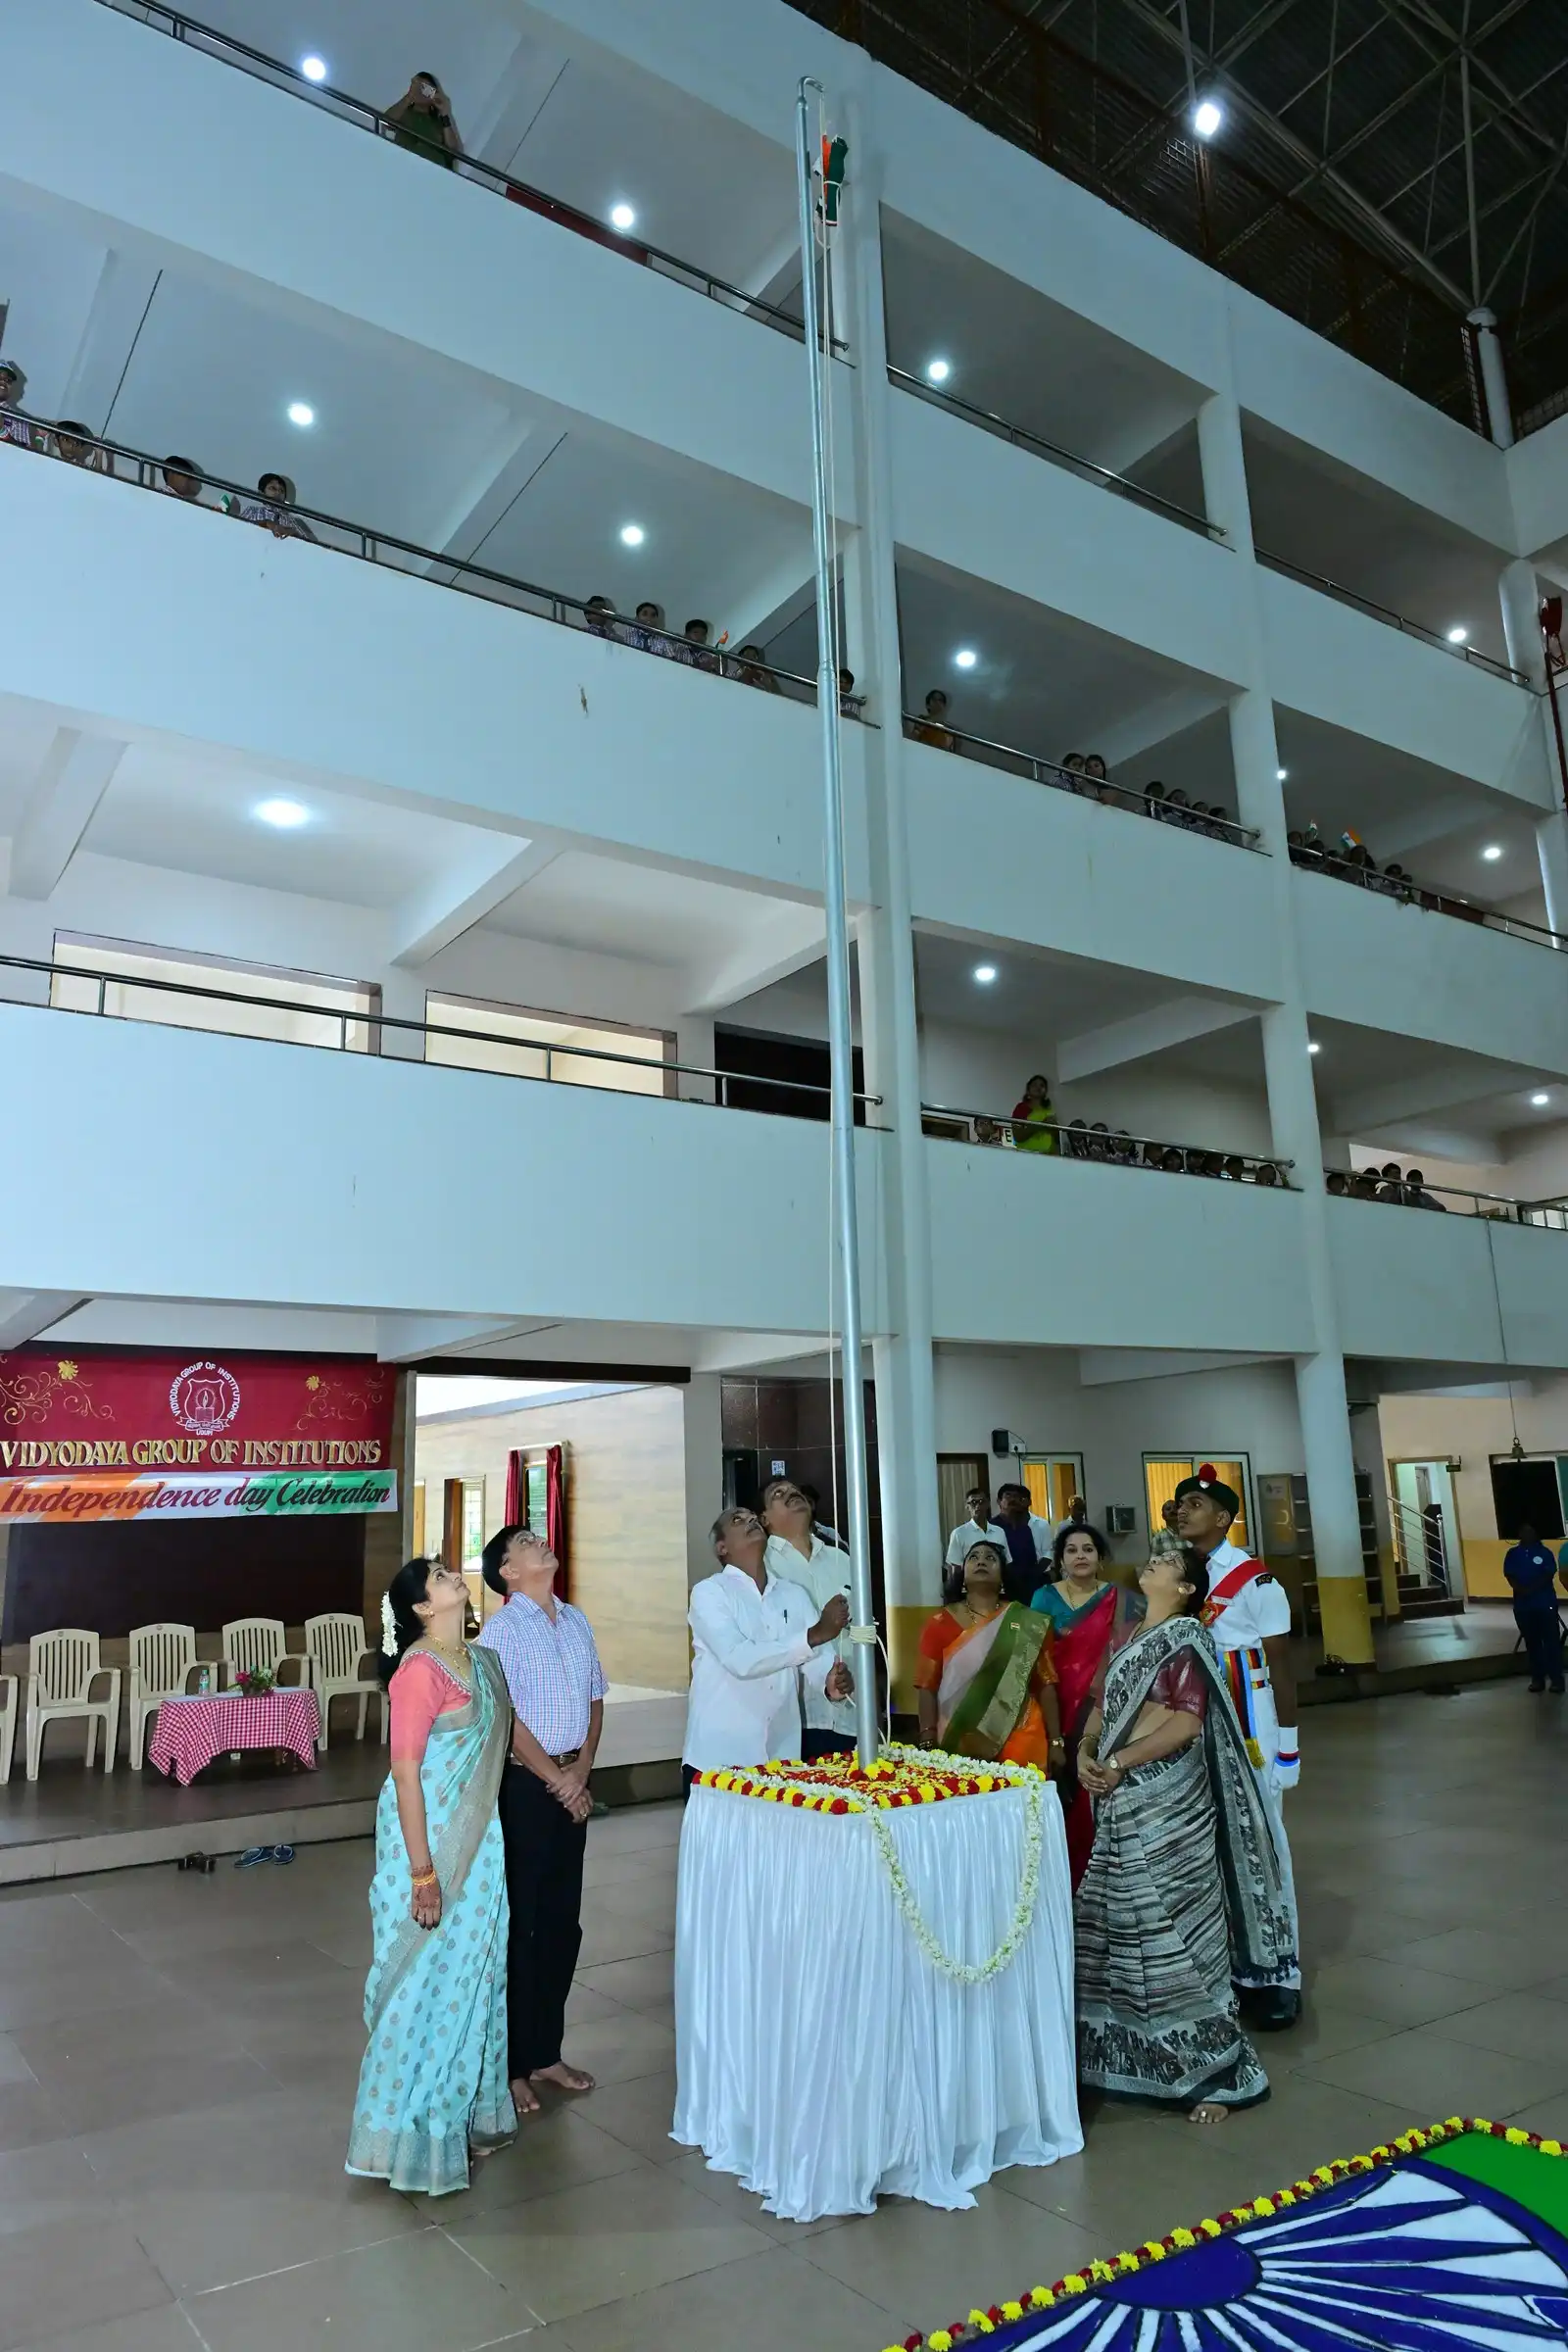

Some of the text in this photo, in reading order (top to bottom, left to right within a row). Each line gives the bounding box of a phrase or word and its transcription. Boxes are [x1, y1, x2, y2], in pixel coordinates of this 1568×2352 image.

[170, 1361, 241, 1421] VIDYODAYA GROUP OF INSTITUTIONS
[0, 1439, 381, 1469] VIDYODAYA GROUP OF INSTITUTIONS
[0, 1477, 390, 1518] Independence day Celebration
